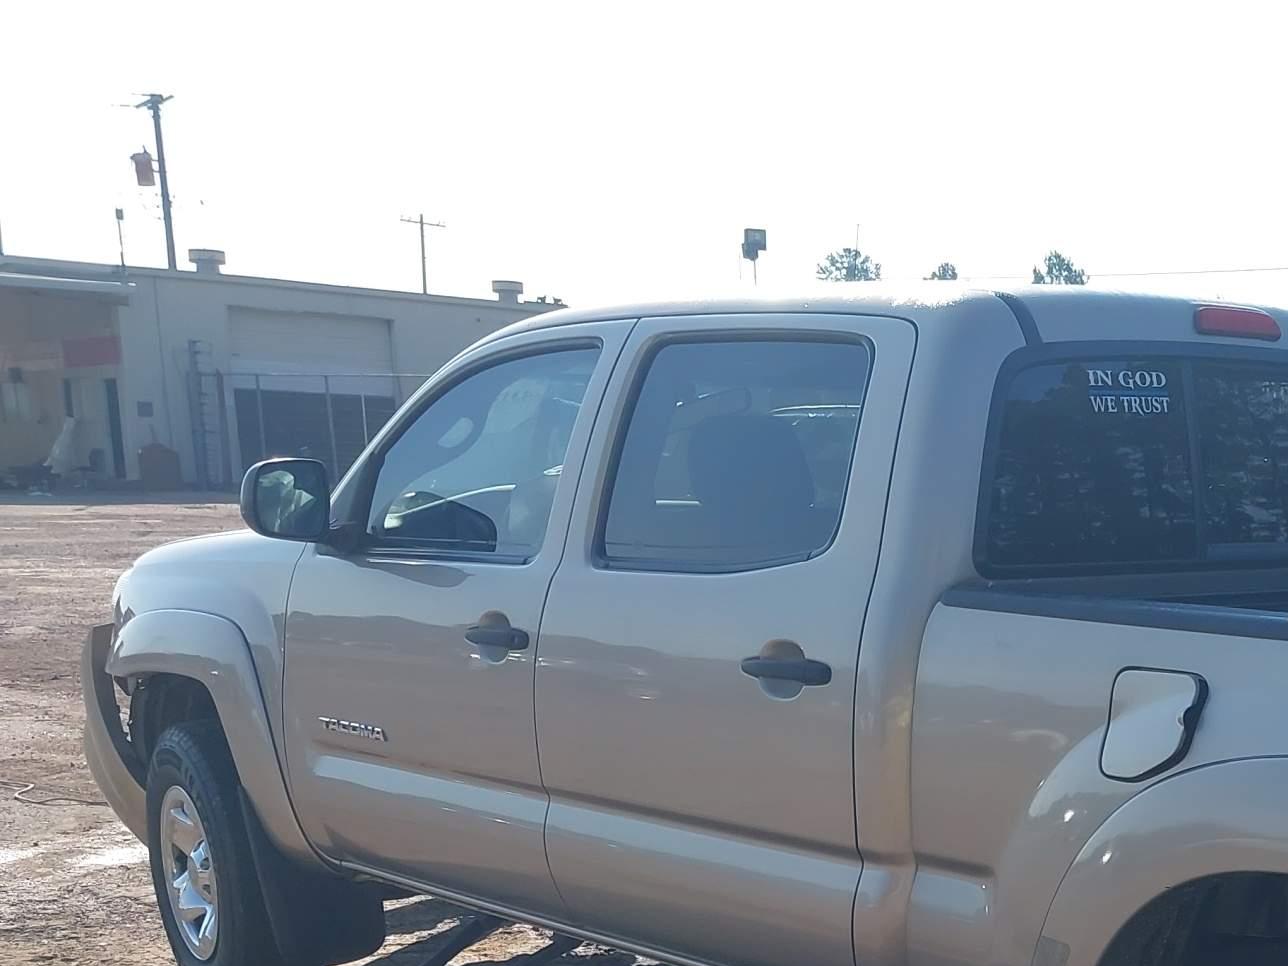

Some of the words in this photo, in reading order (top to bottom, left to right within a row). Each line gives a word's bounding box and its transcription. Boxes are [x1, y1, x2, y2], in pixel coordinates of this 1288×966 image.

[1087, 369, 1112, 386] IN
[1118, 370, 1167, 390] GOD
[1089, 395, 1117, 413] WE
[1120, 396, 1170, 416] TRUST
